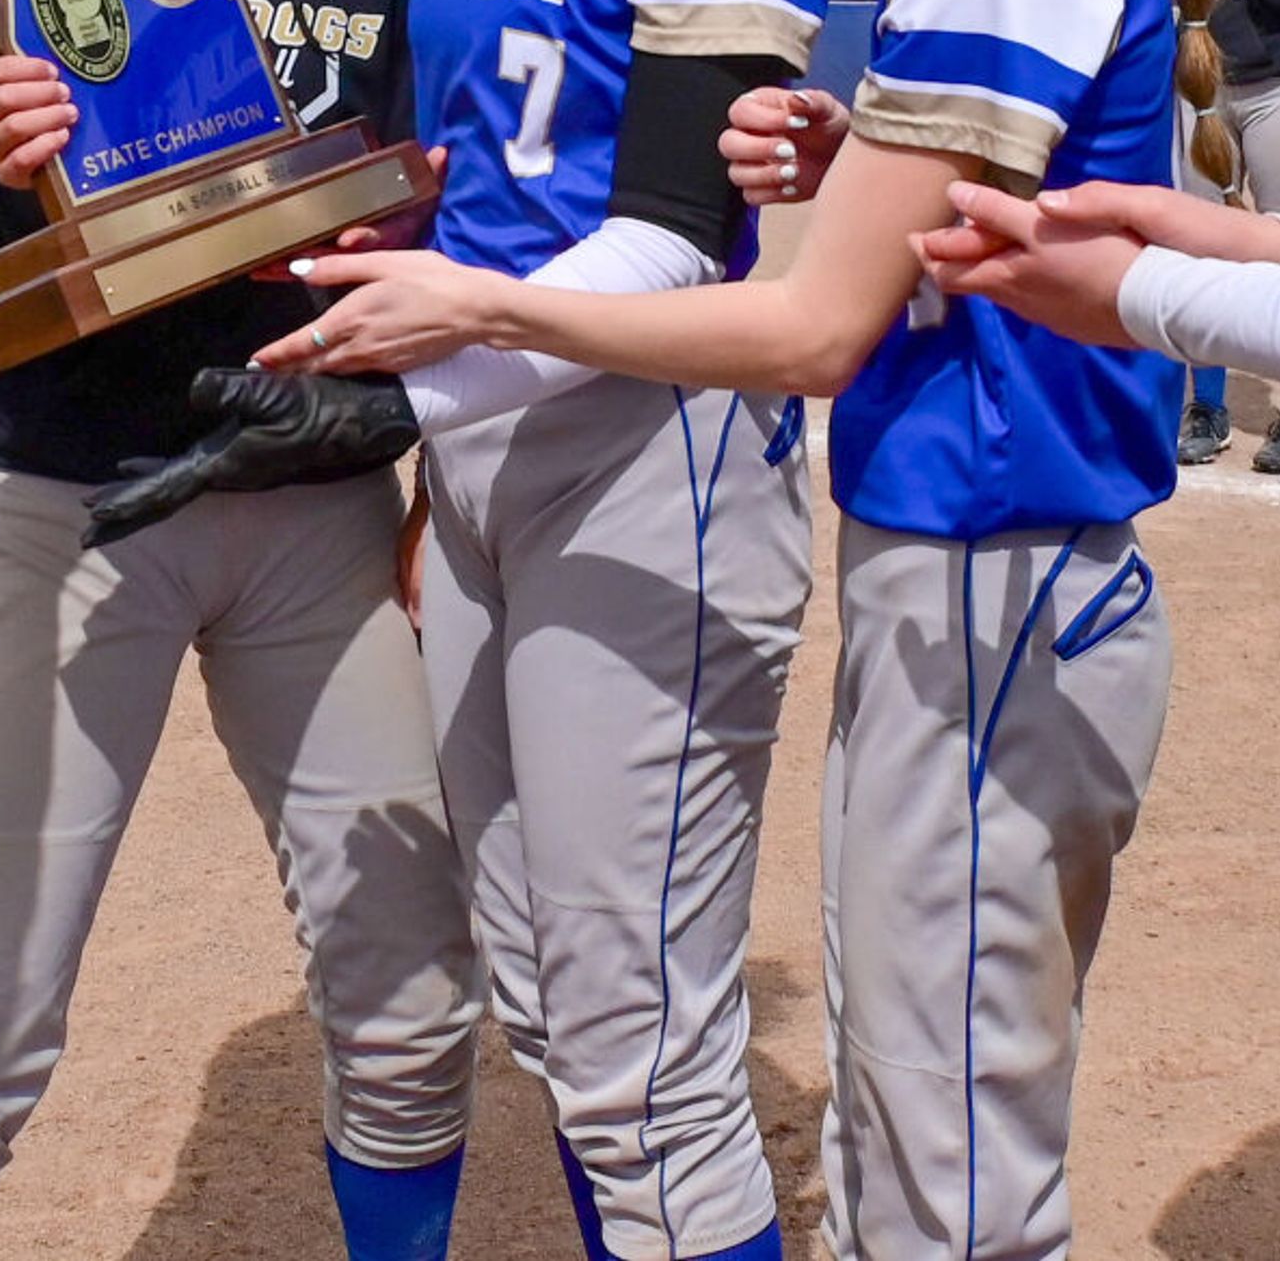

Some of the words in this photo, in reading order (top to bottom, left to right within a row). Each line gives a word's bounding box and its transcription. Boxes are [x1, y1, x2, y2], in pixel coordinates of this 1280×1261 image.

[82, 138, 152, 178] STATE
[155, 102, 265, 153] CHAMPION
[498, 28, 566, 179] 7
[168, 200, 188, 217] 1A
[190, 174, 263, 211] SOFTBALL
